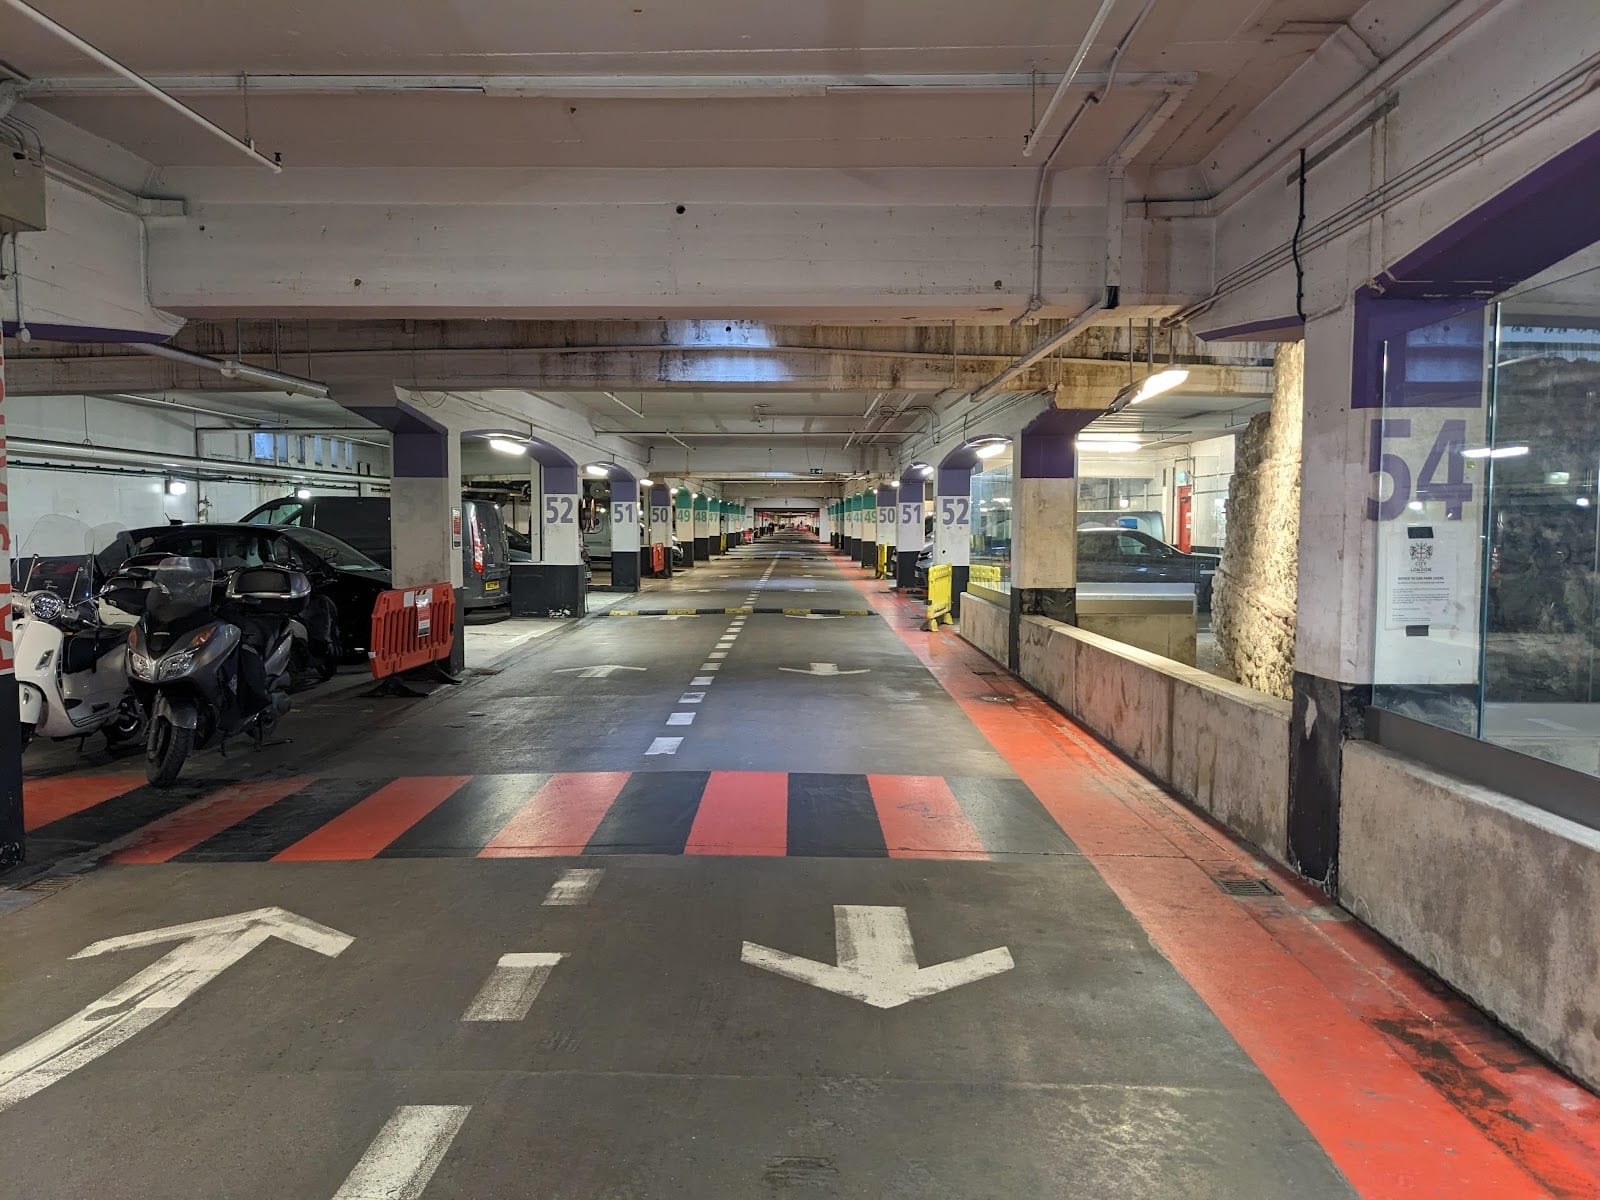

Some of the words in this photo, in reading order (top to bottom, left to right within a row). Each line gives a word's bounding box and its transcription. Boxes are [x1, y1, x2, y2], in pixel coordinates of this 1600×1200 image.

[1366, 418, 1473, 522] 54
[546, 496, 574, 524] 52
[614, 503, 633, 523] 51
[651, 507, 669, 523] 50
[677, 510, 691, 523] 49
[695, 511, 707, 523] 48
[879, 508, 896, 524] 50
[902, 504, 921, 524] 51
[942, 498, 969, 525] 52
